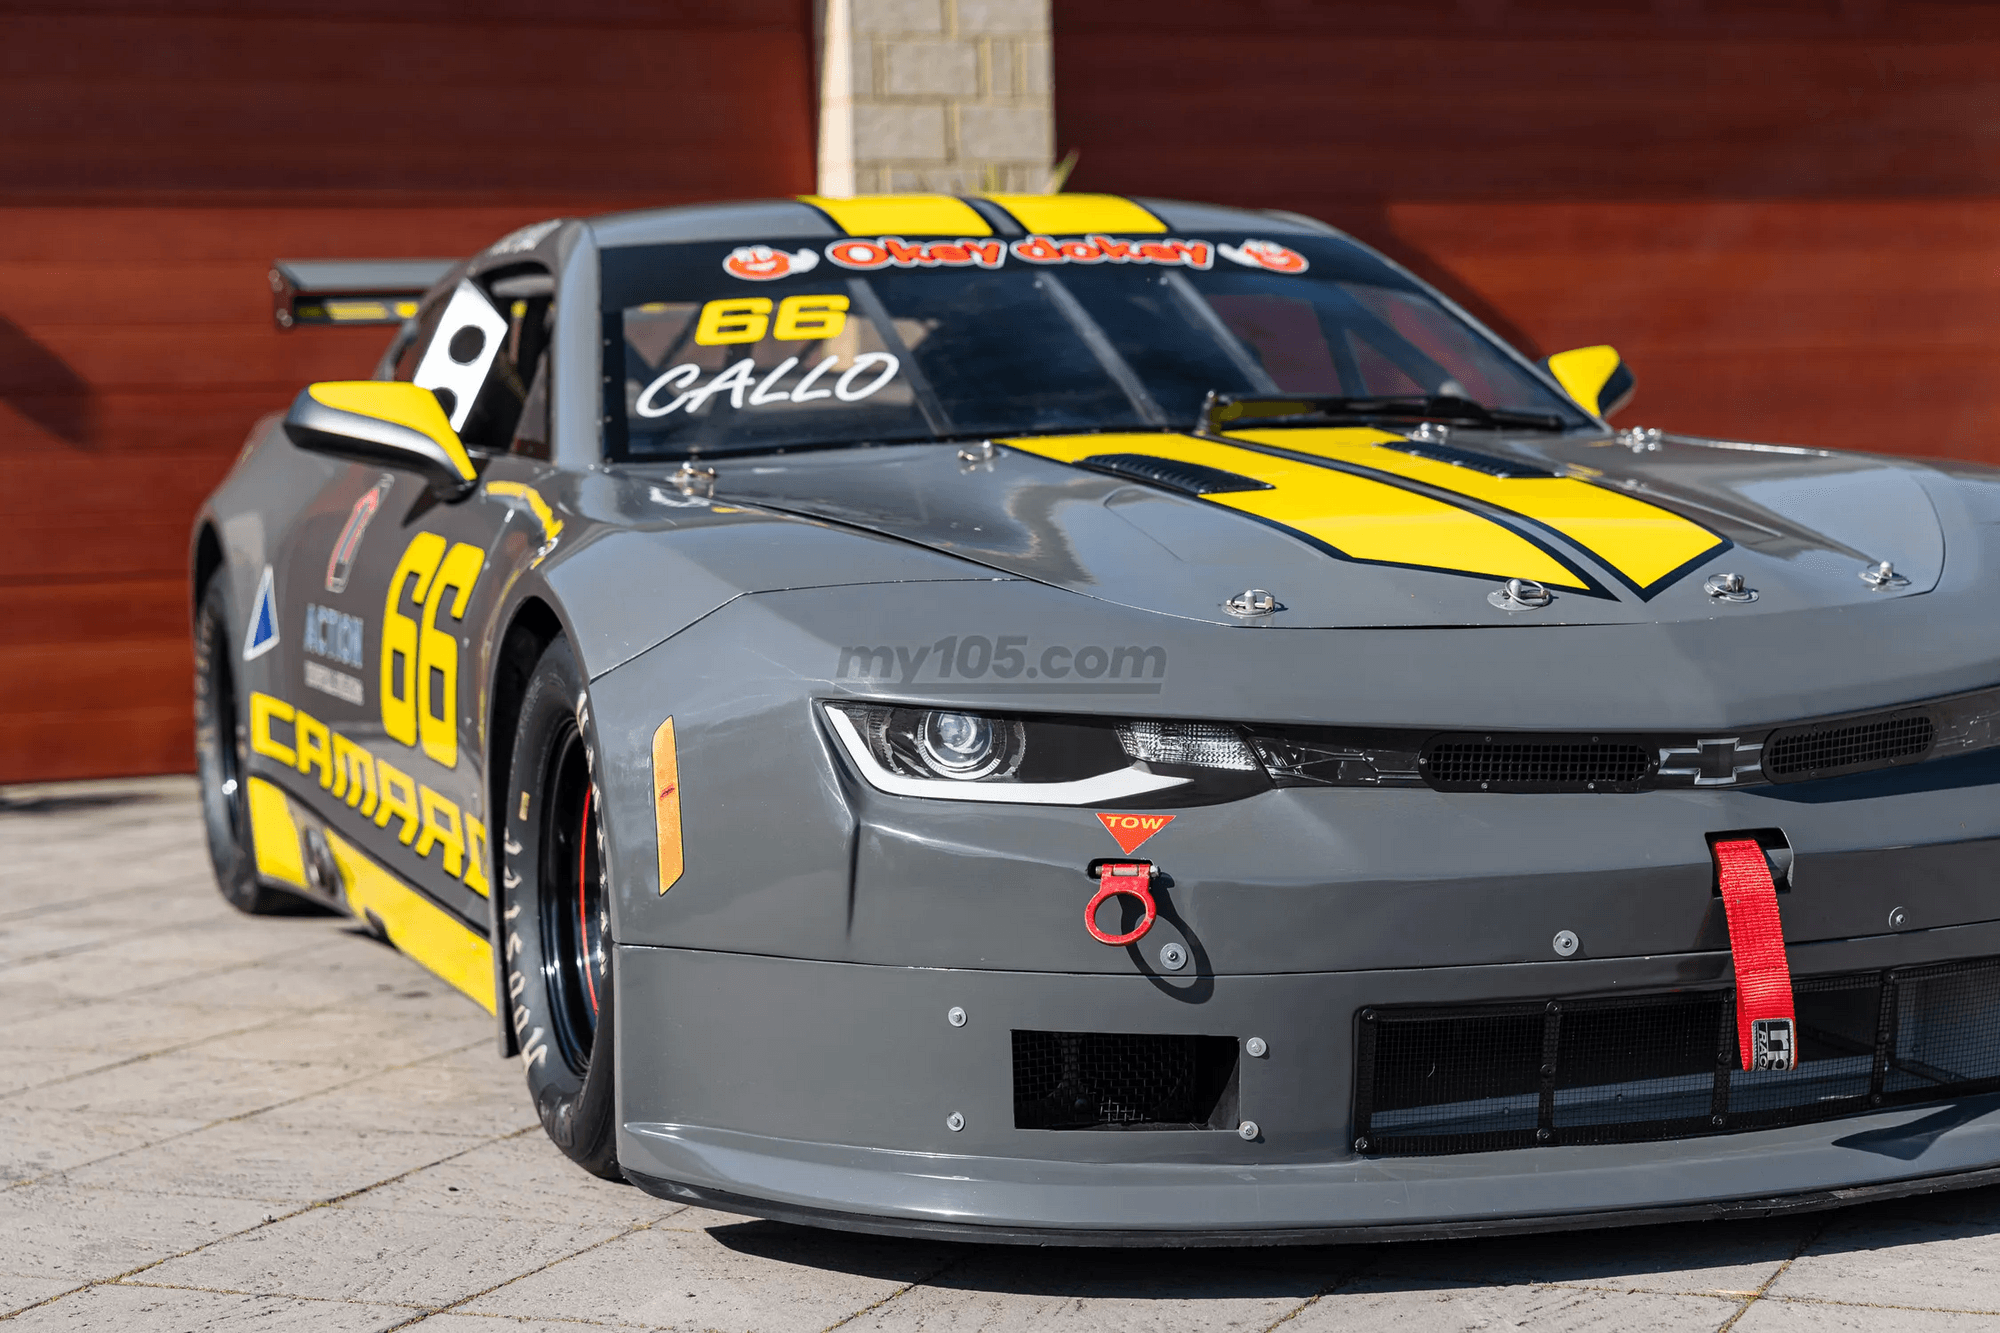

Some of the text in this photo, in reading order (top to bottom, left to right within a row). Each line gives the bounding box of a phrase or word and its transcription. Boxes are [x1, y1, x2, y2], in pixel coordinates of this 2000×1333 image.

[826, 234, 1215, 271] Okey dokey
[695, 294, 850, 346] 66
[635, 351, 900, 418] CALLO
[381, 531, 486, 769] 66
[1106, 816, 1164, 830] TOW
